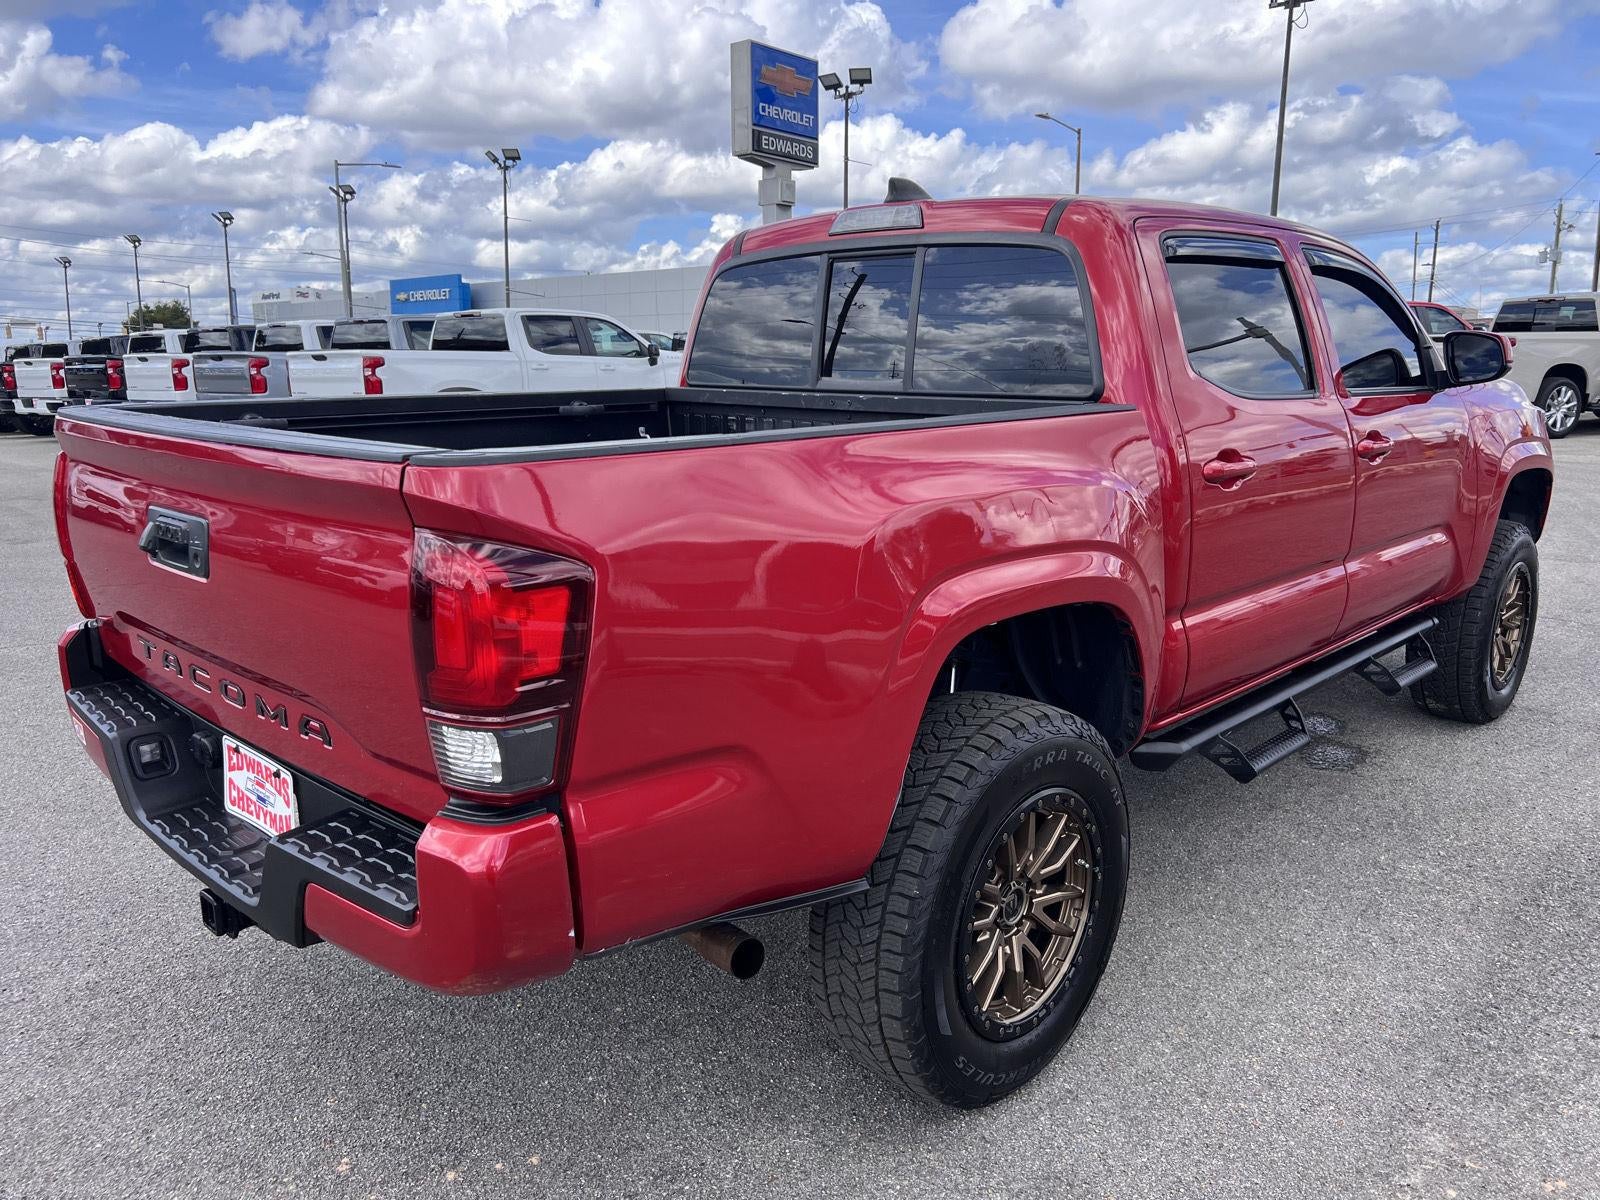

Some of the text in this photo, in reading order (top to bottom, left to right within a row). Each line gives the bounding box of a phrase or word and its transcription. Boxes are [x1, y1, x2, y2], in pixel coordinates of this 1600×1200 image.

[759, 102, 814, 127] CHEVROLET
[762, 135, 813, 158] EDWARDS
[409, 288, 450, 302] CHEVROLET
[137, 635, 333, 750] TACOMA
[226, 743, 291, 809] EDWARDS
[1076, 750, 1110, 780] TRAC
[228, 776, 291, 834] CHEVYMAN
